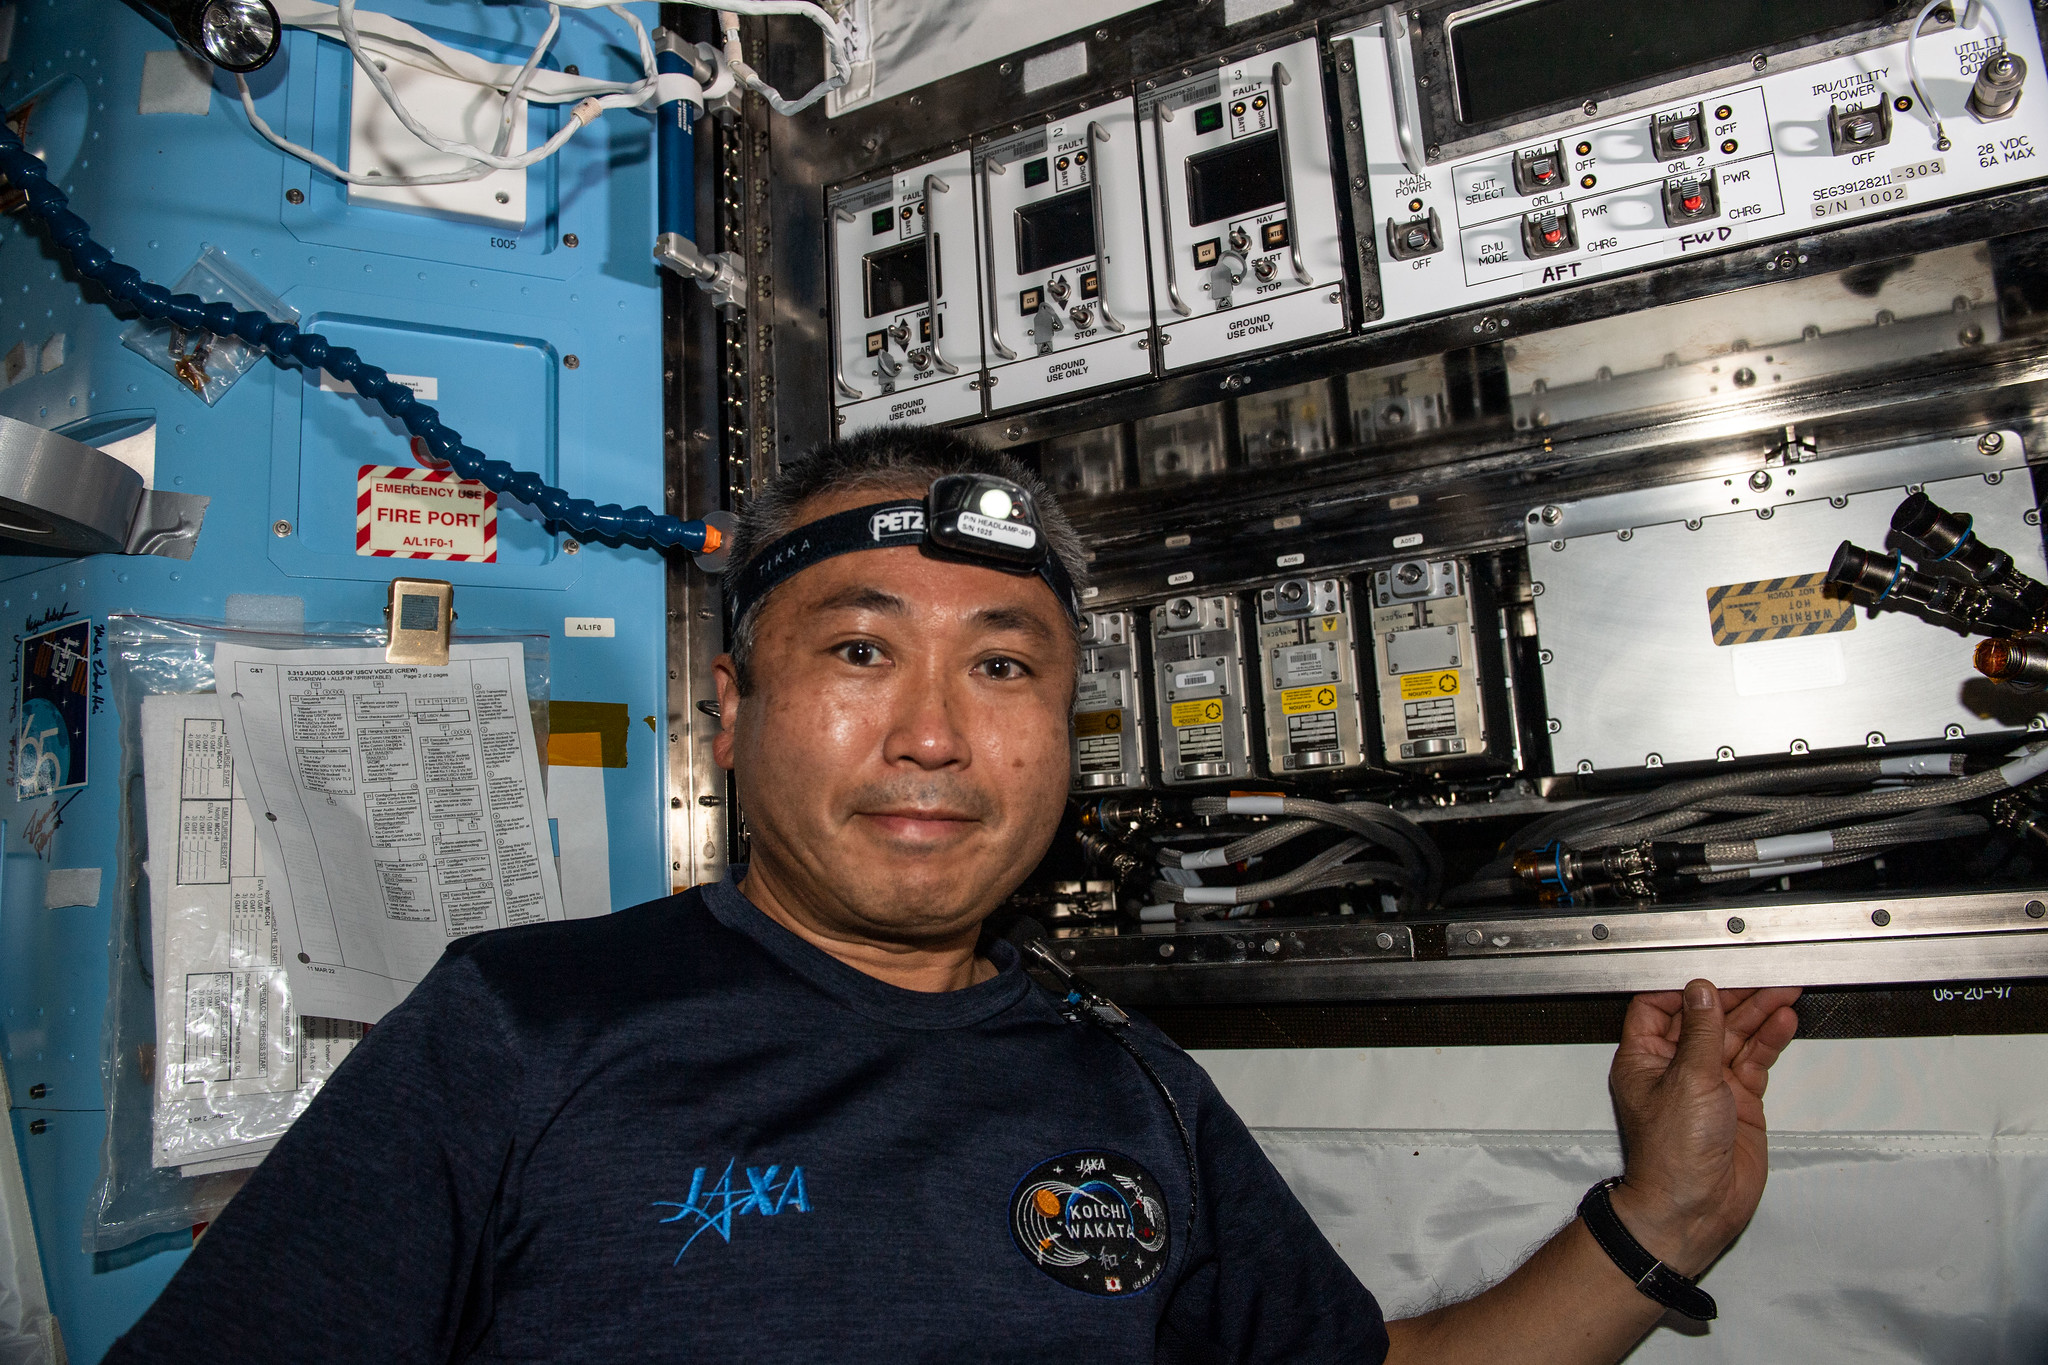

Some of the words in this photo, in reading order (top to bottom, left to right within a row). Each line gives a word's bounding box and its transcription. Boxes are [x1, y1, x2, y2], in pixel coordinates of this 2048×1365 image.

[1954, 36, 2003, 55] UTILIT
[1235, 69, 1242, 81] 3
[1811, 67, 1890, 97] IRU/UTILITY
[1233, 81, 1263, 97] FAULT
[1830, 83, 1876, 104] POWER
[1845, 101, 1863, 113] ON
[1237, 117, 1246, 133] BATT
[1258, 110, 1267, 129] CHGR
[1053, 128, 1064, 138] 2
[1715, 121, 1737, 137] OFF
[1057, 138, 1084, 152] FAULT
[1977, 144, 1995, 156] 28
[2000, 136, 2029, 150] VDC
[1575, 158, 1596, 171] OFF
[1667, 160, 1690, 174] ORL
[1697, 156, 1705, 167] 2
[1851, 151, 1876, 166] OFF
[1980, 155, 1999, 168] 6A
[2004, 147, 2036, 162] MAX
[901, 179, 906, 188] 1
[1399, 173, 1426, 188] MAIN
[1472, 178, 1496, 193] SUIT
[1722, 170, 1751, 185] PWR
[1395, 181, 1432, 198] POWER
[1465, 187, 1505, 206] SELECT
[1532, 195, 1554, 207] ORL
[1559, 191, 1565, 201] 1
[1815, 200, 1848, 217] S/N
[1859, 188, 1905, 208] 1002
[1256, 214, 1274, 224] NAV
[1410, 213, 1424, 222] ON
[1581, 204, 1608, 219] PWR
[1729, 203, 1762, 219] CHRG
[1267, 230, 1284, 239] ENTER
[1679, 226, 1731, 251] FWD
[491, 237, 517, 250] E005
[1481, 241, 1504, 255] EMU
[1587, 237, 1618, 252] CHRG
[1412, 258, 1432, 271] OFF
[1478, 250, 1509, 266] MODE
[1076, 265, 1091, 274] NAV
[1542, 262, 1582, 284] AFT
[1256, 281, 1282, 295] STOP
[1076, 301, 1098, 312] TART
[1229, 314, 1271, 330] GROUND
[1074, 328, 1098, 340] STOP
[1227, 330, 1246, 340] USE
[1248, 322, 1274, 335] ONLY
[1048, 358, 1086, 374] GROUND
[913, 370, 934, 381] STOP
[1046, 372, 1063, 383] USE
[1065, 366, 1089, 379] ONLY
[889, 411, 905, 421] USE
[905, 405, 927, 418] ONLY
[891, 398, 924, 413] GROUND
[375, 483, 455, 498] EMERGENCY
[458, 489, 482, 500] USE
[377, 507, 421, 524] FIRE
[428, 511, 480, 528] PORT
[963, 514, 976, 524] P/N
[978, 518, 1031, 537] HEADLAMP-301
[873, 512, 924, 541] PETZ
[962, 523, 974, 532] S/N
[977, 526, 993, 537] 1025
[403, 536, 454, 549] A/L1F0-1
[1401, 537, 1416, 545] A057
[759, 539, 810, 576] TIKKA
[1283, 555, 1298, 564] A056
[1174, 573, 1188, 582] A055
[1768, 591, 1794, 600] TOUCH
[1799, 588, 1815, 596] NOT
[1789, 599, 1811, 610] HOT
[1771, 609, 1832, 625] WARNING
[1076, 1158, 1106, 1178] JAXA
[652, 1157, 813, 1266] JAXA
[1070, 1203, 1127, 1220] KOICHI
[1065, 1223, 1135, 1239] WAKATA
